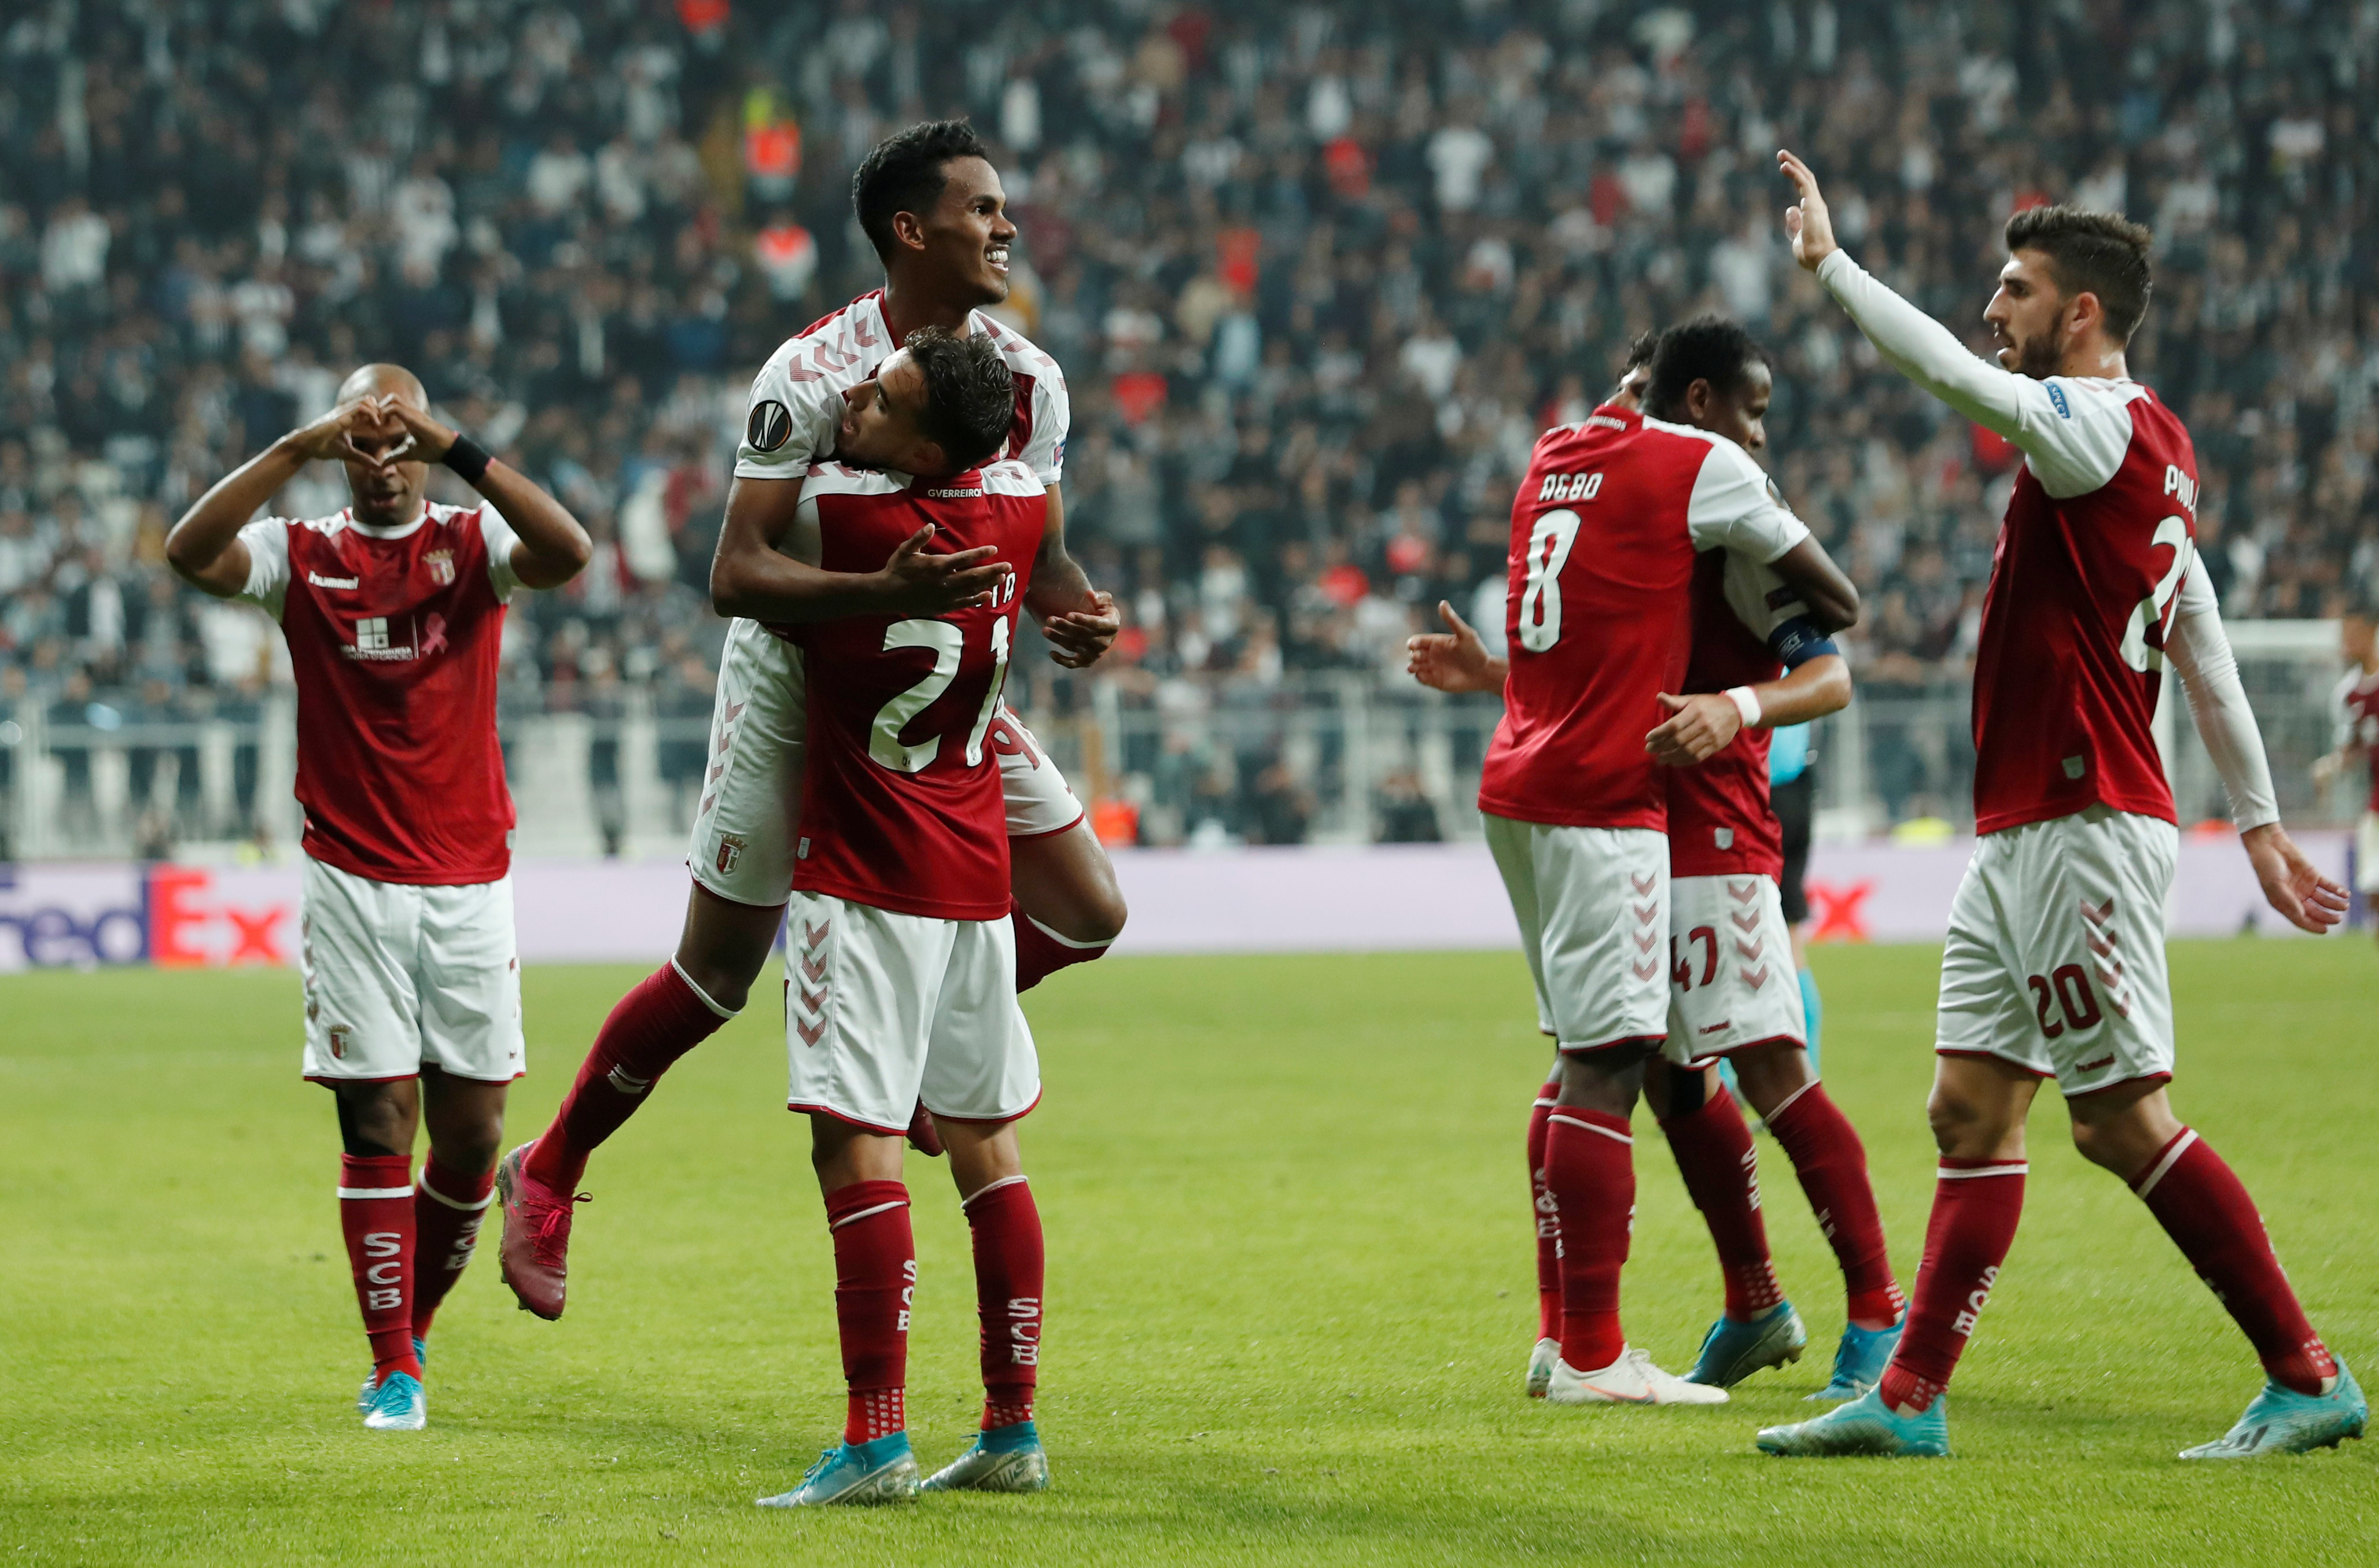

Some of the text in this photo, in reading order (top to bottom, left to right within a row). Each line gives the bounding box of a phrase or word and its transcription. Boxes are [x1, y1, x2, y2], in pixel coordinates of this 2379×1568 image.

[1539, 473, 1604, 501] AGBO
[1519, 508, 1582, 653] 8
[868, 615, 1010, 773] 21
[1671, 925, 1718, 992] 47
[2028, 963, 2102, 1039] 20
[364, 1231, 403, 1311] SCB
[1007, 1297, 1040, 1366] SCB
